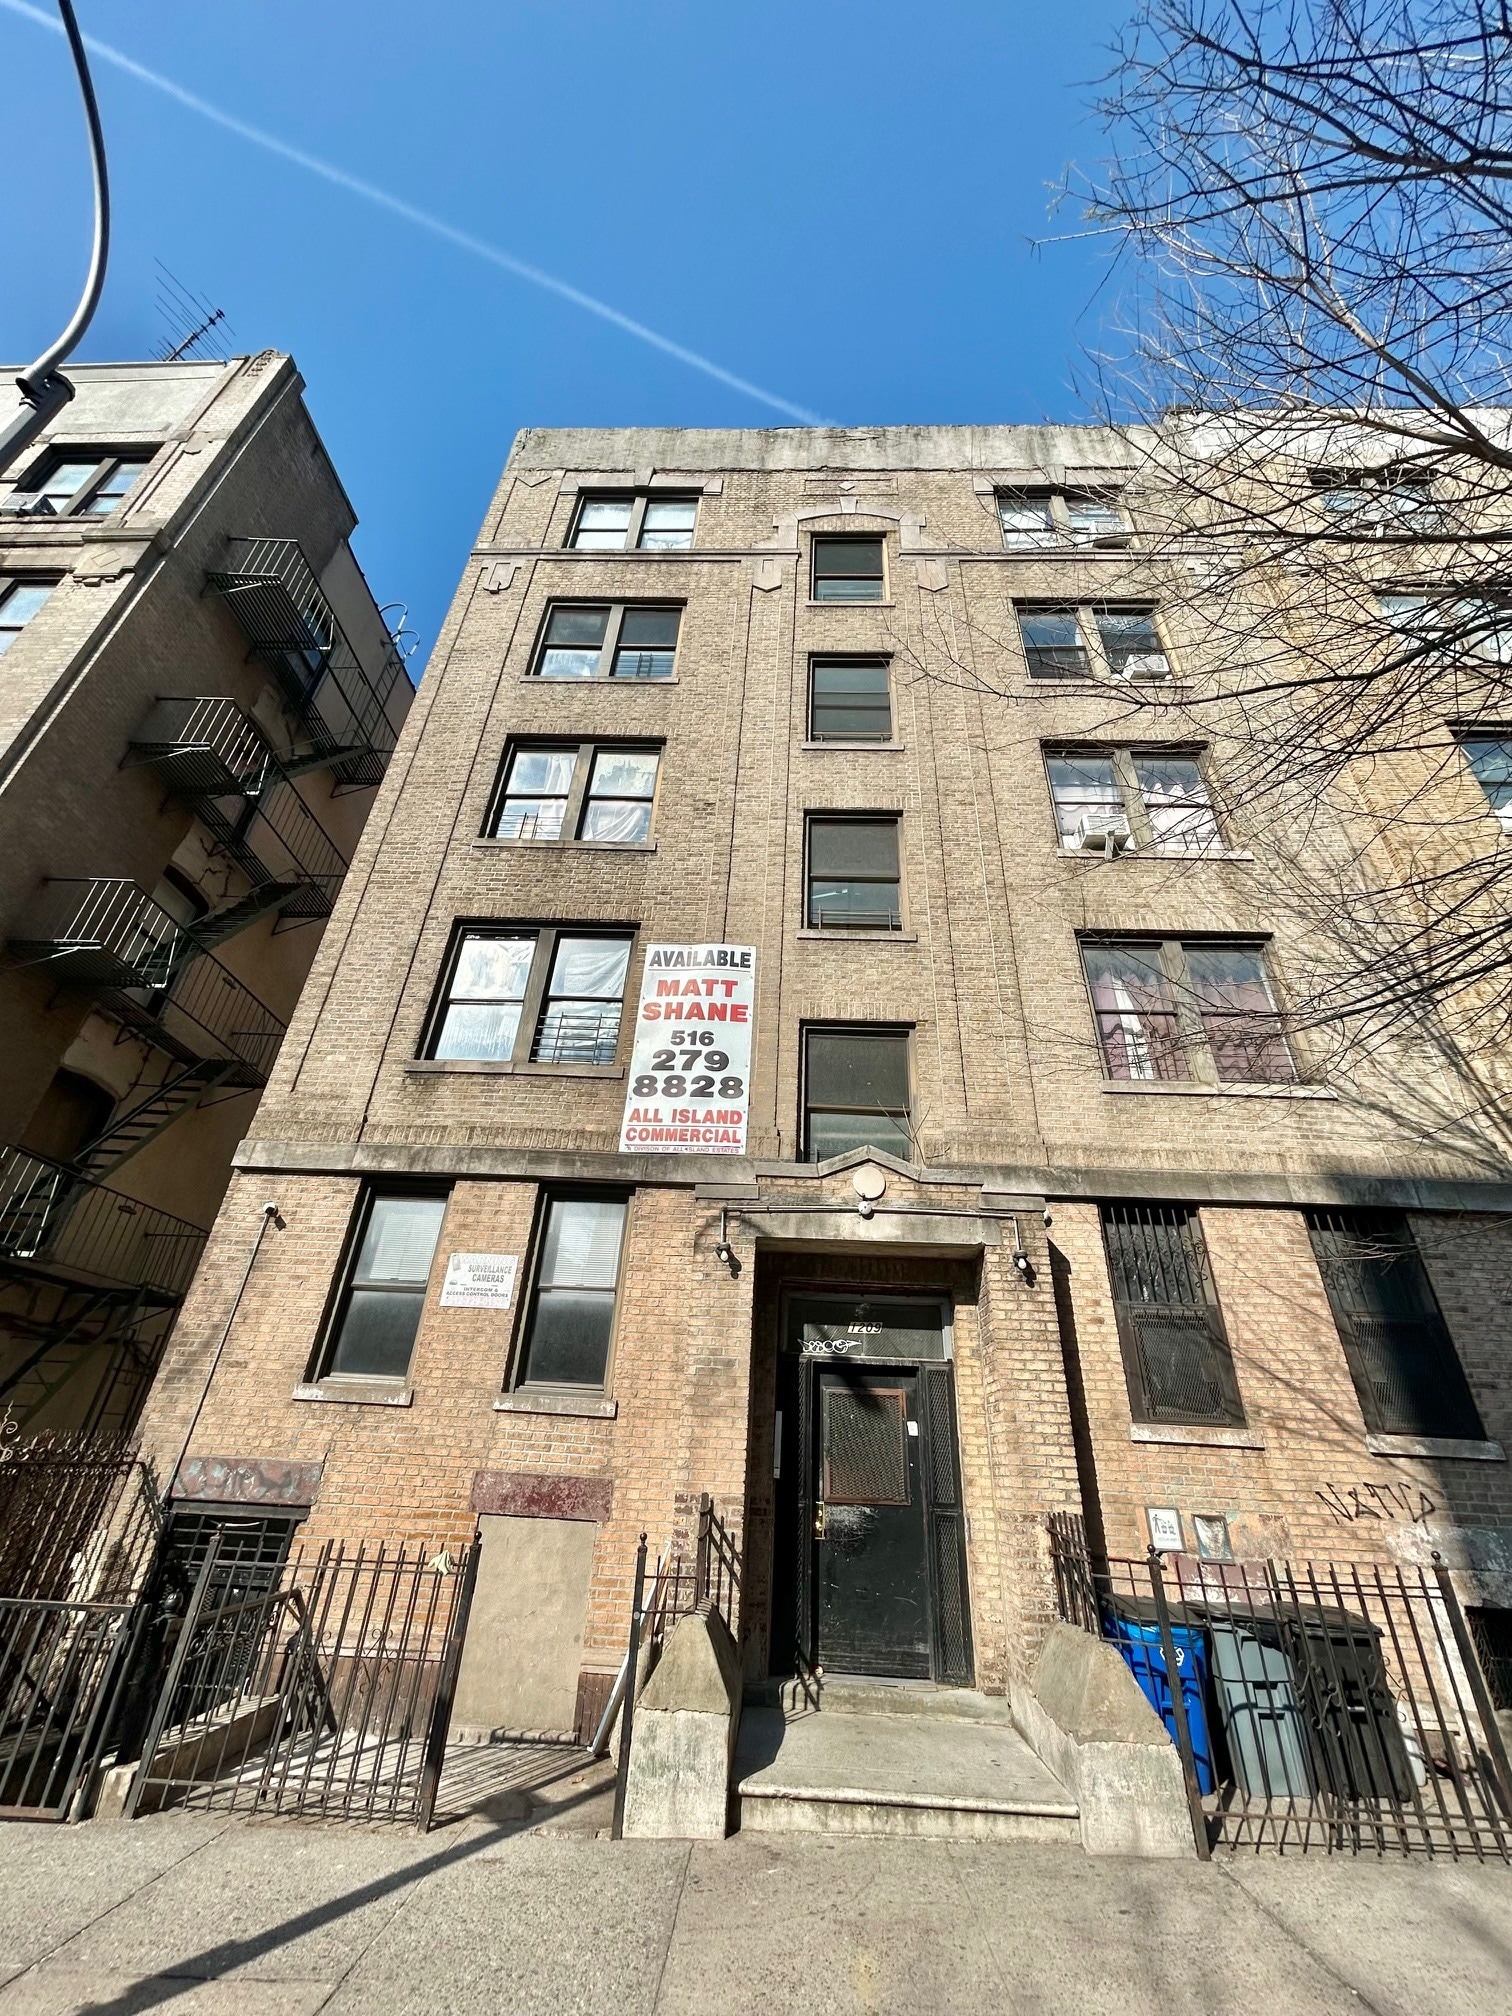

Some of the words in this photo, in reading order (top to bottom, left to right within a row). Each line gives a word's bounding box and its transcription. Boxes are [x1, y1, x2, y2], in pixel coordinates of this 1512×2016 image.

[649, 950, 751, 968] AVAILABLE
[656, 979, 738, 997] MATT
[642, 1002, 748, 1022] SHANE
[670, 1030, 714, 1046] 516
[651, 1049, 730, 1072] 279
[632, 1074, 744, 1099] 8828
[628, 1108, 663, 1123] ALL
[671, 1109, 742, 1124] ISLAND
[625, 1127, 741, 1143] COMMERCIAL
[468, 1264, 512, 1274] SURVEILLANCE
[472, 1273, 505, 1283] CAMERAS
